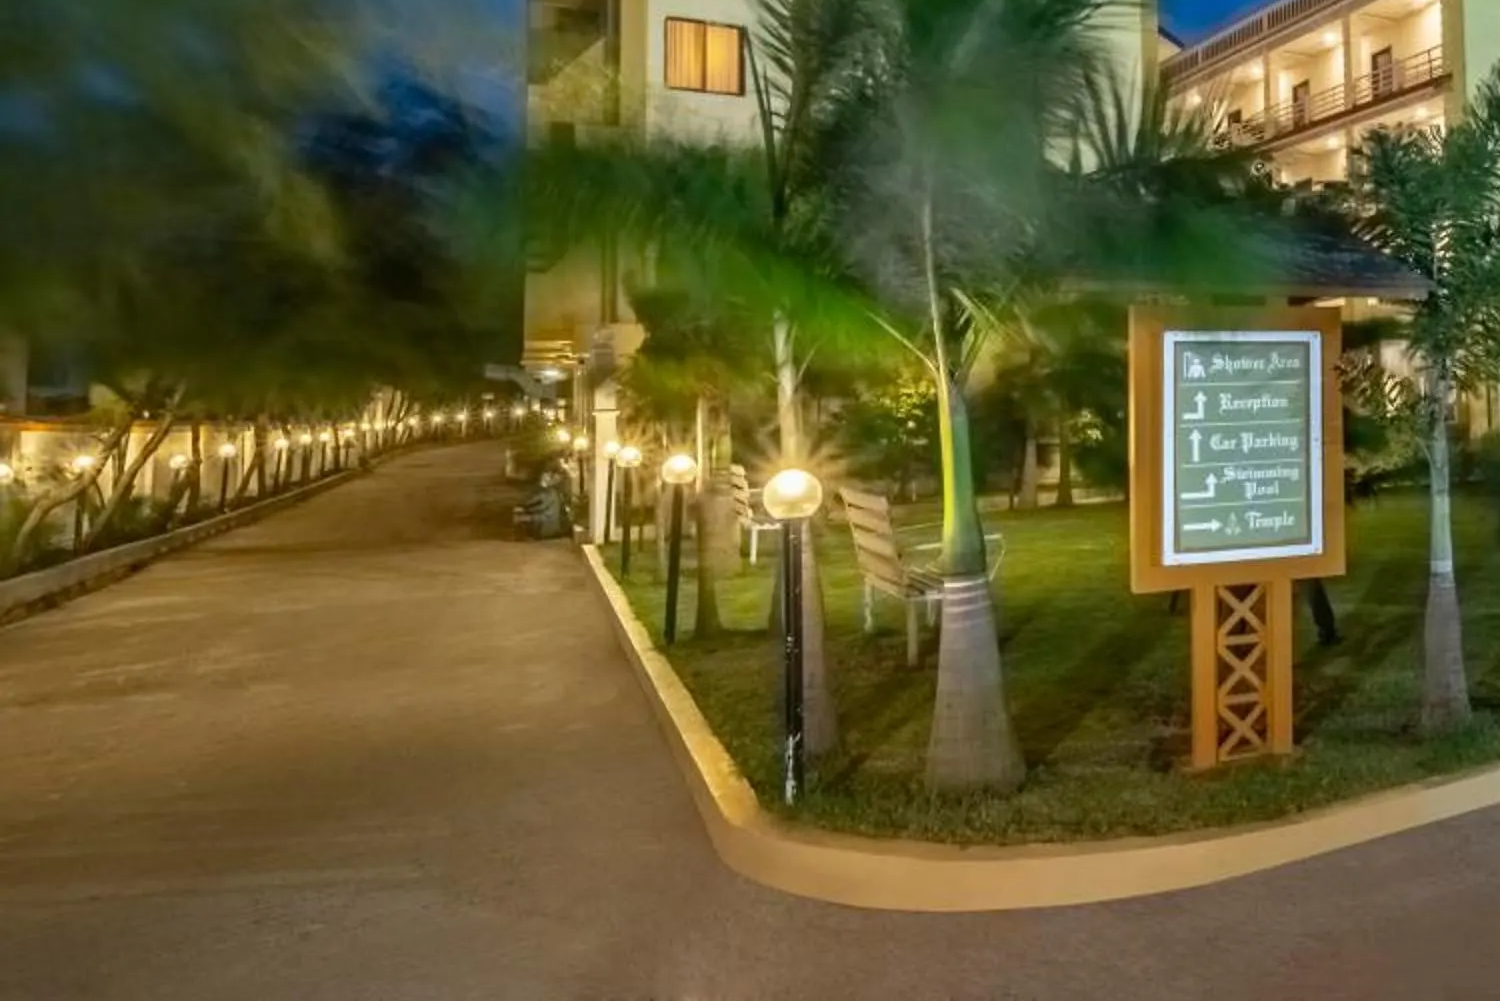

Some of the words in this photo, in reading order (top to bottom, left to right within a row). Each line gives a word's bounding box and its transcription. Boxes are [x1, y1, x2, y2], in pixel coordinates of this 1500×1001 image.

[1209, 352, 1265, 375] Shower
[1266, 351, 1300, 374] Area
[1218, 392, 1289, 415] Reception
[1209, 433, 1237, 451] Car
[1240, 431, 1299, 453] Parking
[1220, 466, 1300, 484] Swimming
[1244, 480, 1279, 500] Pool
[1244, 510, 1295, 533] Temple
